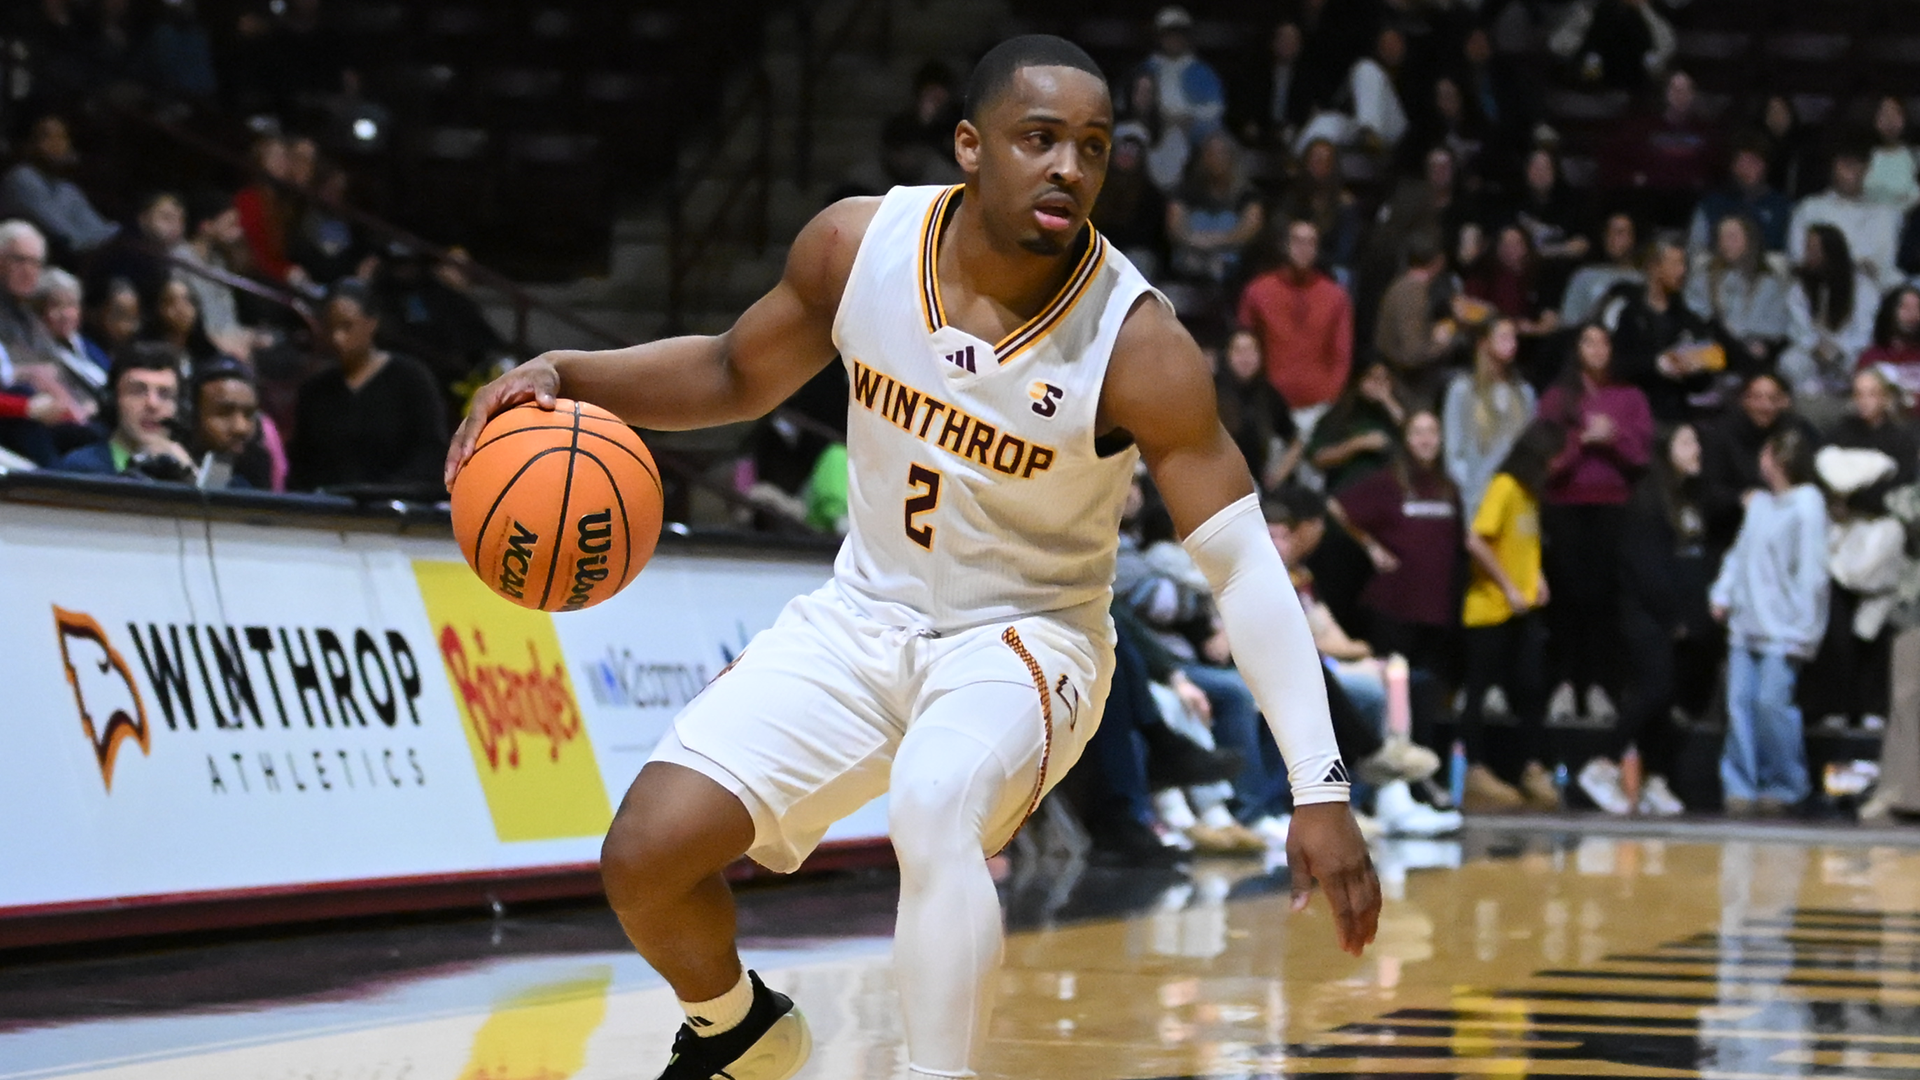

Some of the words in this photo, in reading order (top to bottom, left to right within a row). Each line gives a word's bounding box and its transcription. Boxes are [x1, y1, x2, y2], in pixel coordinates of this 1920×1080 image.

[853, 357, 1057, 480] WINTHROP
[904, 461, 942, 552] 2
[499, 520, 539, 599] NCAA
[127, 621, 421, 731] WINTHROP
[206, 748, 426, 793] ATHLETICS
